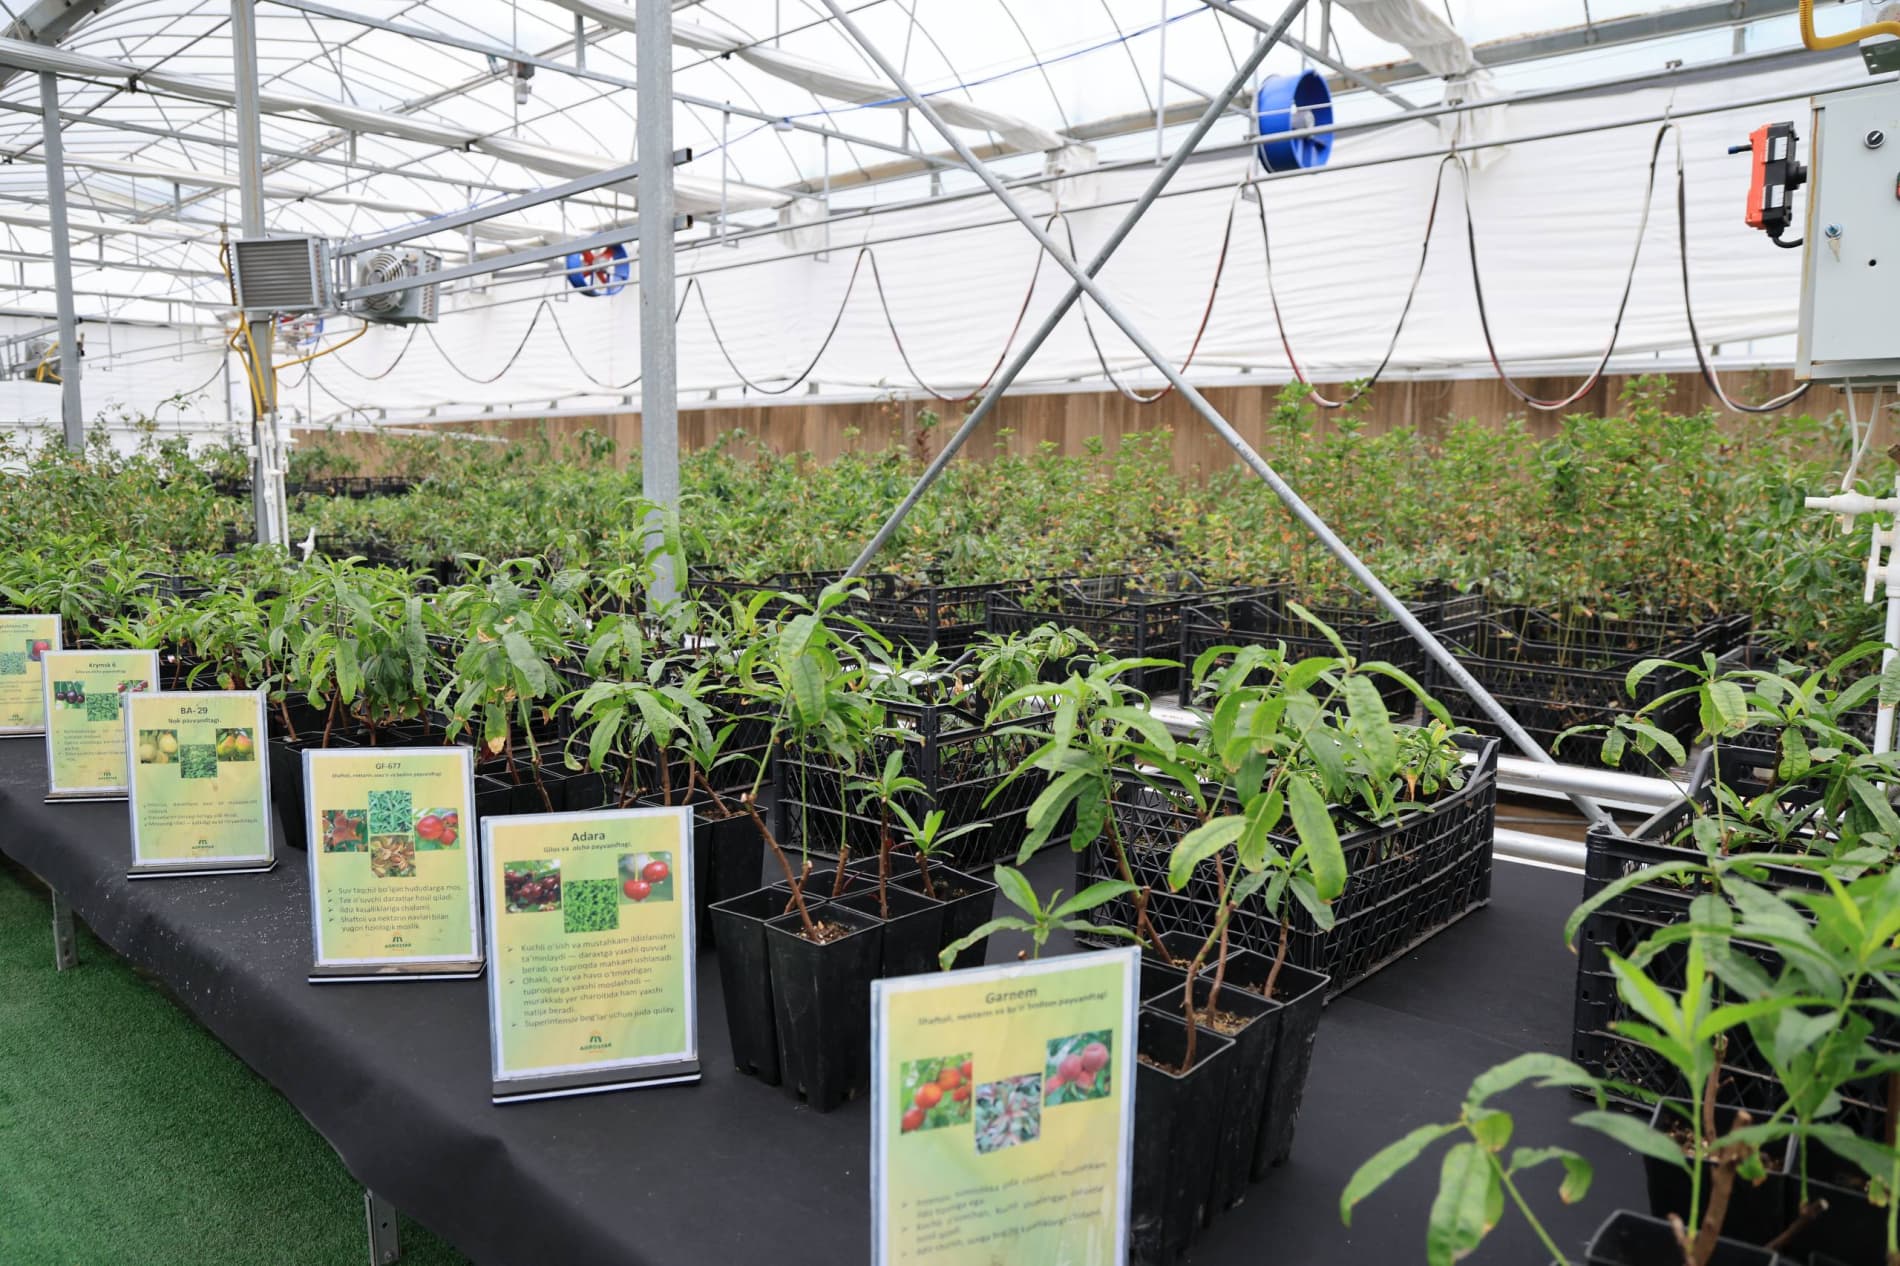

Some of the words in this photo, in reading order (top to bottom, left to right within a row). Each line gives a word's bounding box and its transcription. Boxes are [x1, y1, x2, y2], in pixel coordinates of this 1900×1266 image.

[571, 831, 606, 842] Adara
[521, 944, 545, 952] Kuchli
[583, 936, 629, 948] mustahkam
[578, 950, 613, 960] daraxtga
[615, 946, 638, 956] yaxshi
[522, 966, 547, 974] beradi
[561, 962, 597, 974] tuproqda
[599, 958, 633, 968] mahkam
[635, 954, 672, 964] ushlanadi
[524, 986, 569, 996] tuproqlarga
[572, 983, 596, 992] yaxshi
[598, 978, 641, 989] moslashadi
[524, 996, 563, 1006] murakkab
[565, 996, 577, 1004] yer
[580, 990, 618, 1001] sharoitida
[620, 989, 637, 997] ham
[640, 986, 663, 997] yaxshi
[985, 988, 1038, 1004] Garnem
[524, 1008, 546, 1017] natija
[548, 1006, 576, 1014] beradi.
